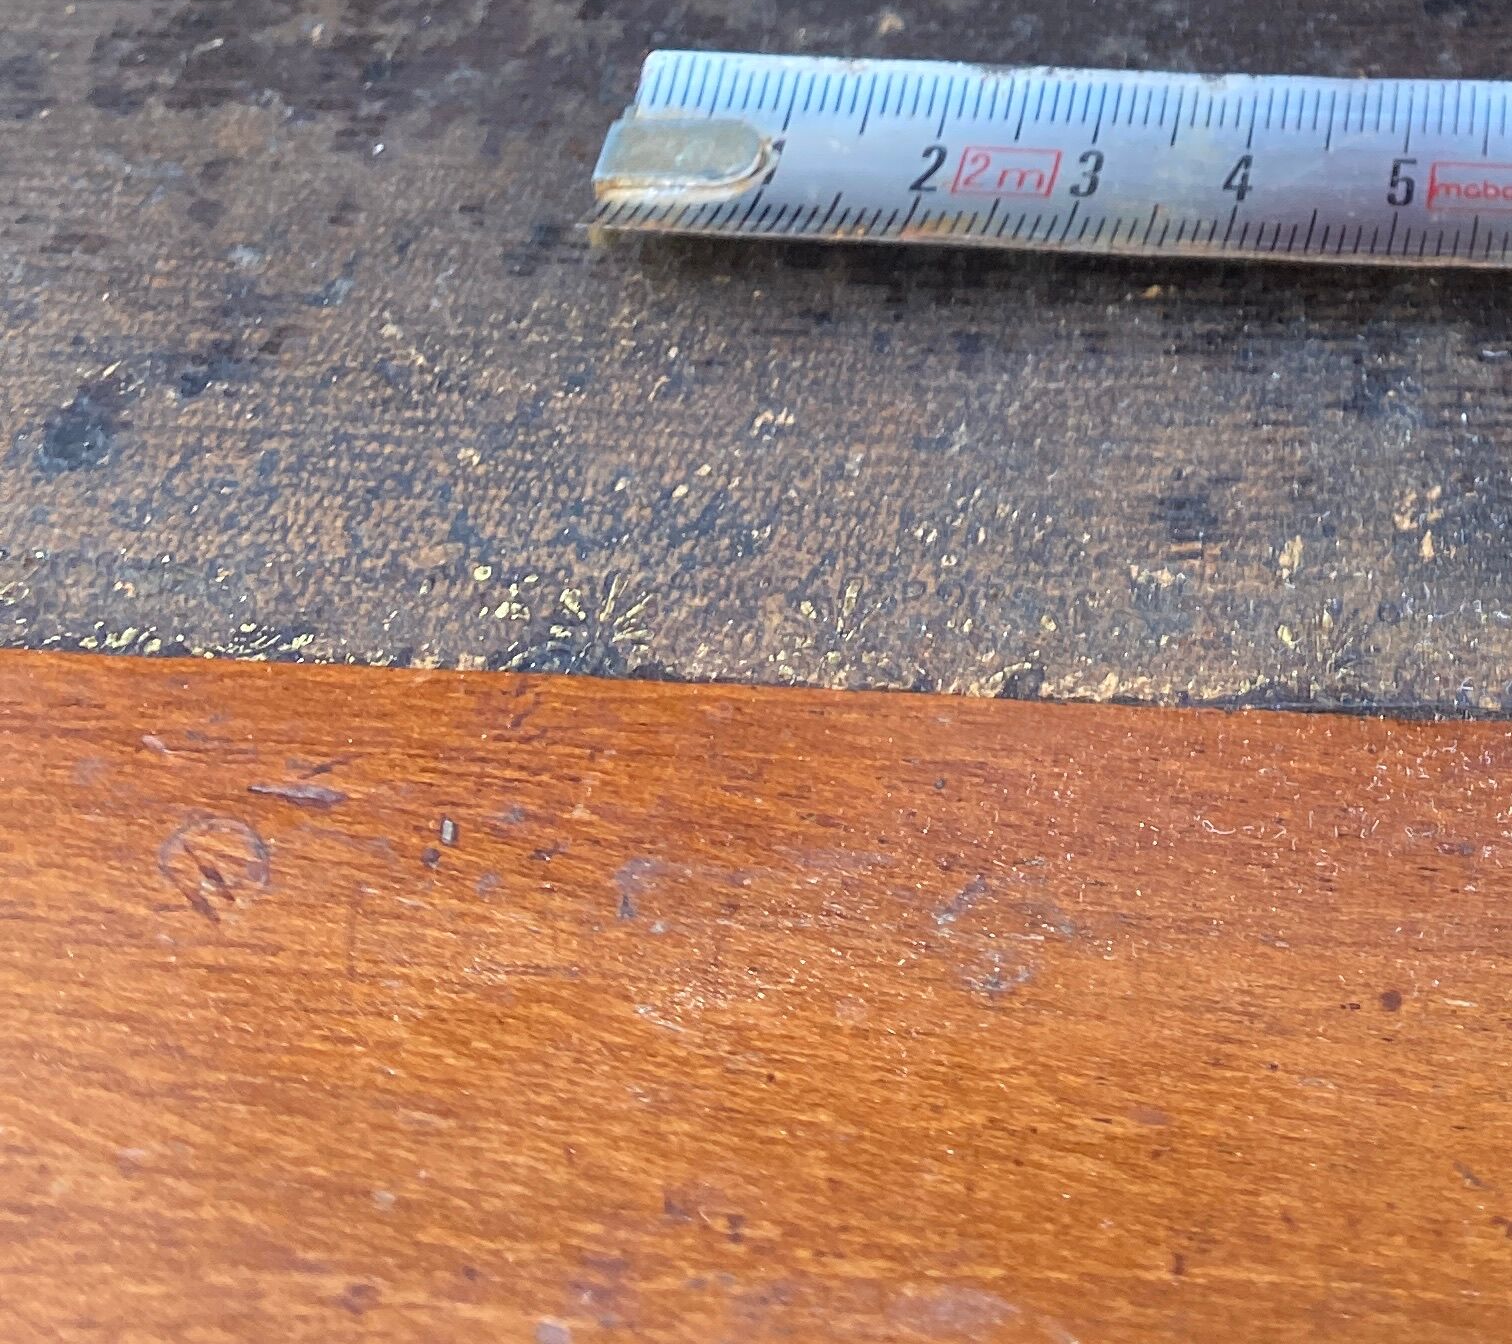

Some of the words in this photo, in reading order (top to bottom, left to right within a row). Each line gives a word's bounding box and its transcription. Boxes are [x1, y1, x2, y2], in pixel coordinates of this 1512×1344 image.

[908, 144, 947, 192] 2
[1069, 149, 1105, 198] 3
[1223, 155, 1253, 201] 4
[1386, 159, 1417, 206] 5
